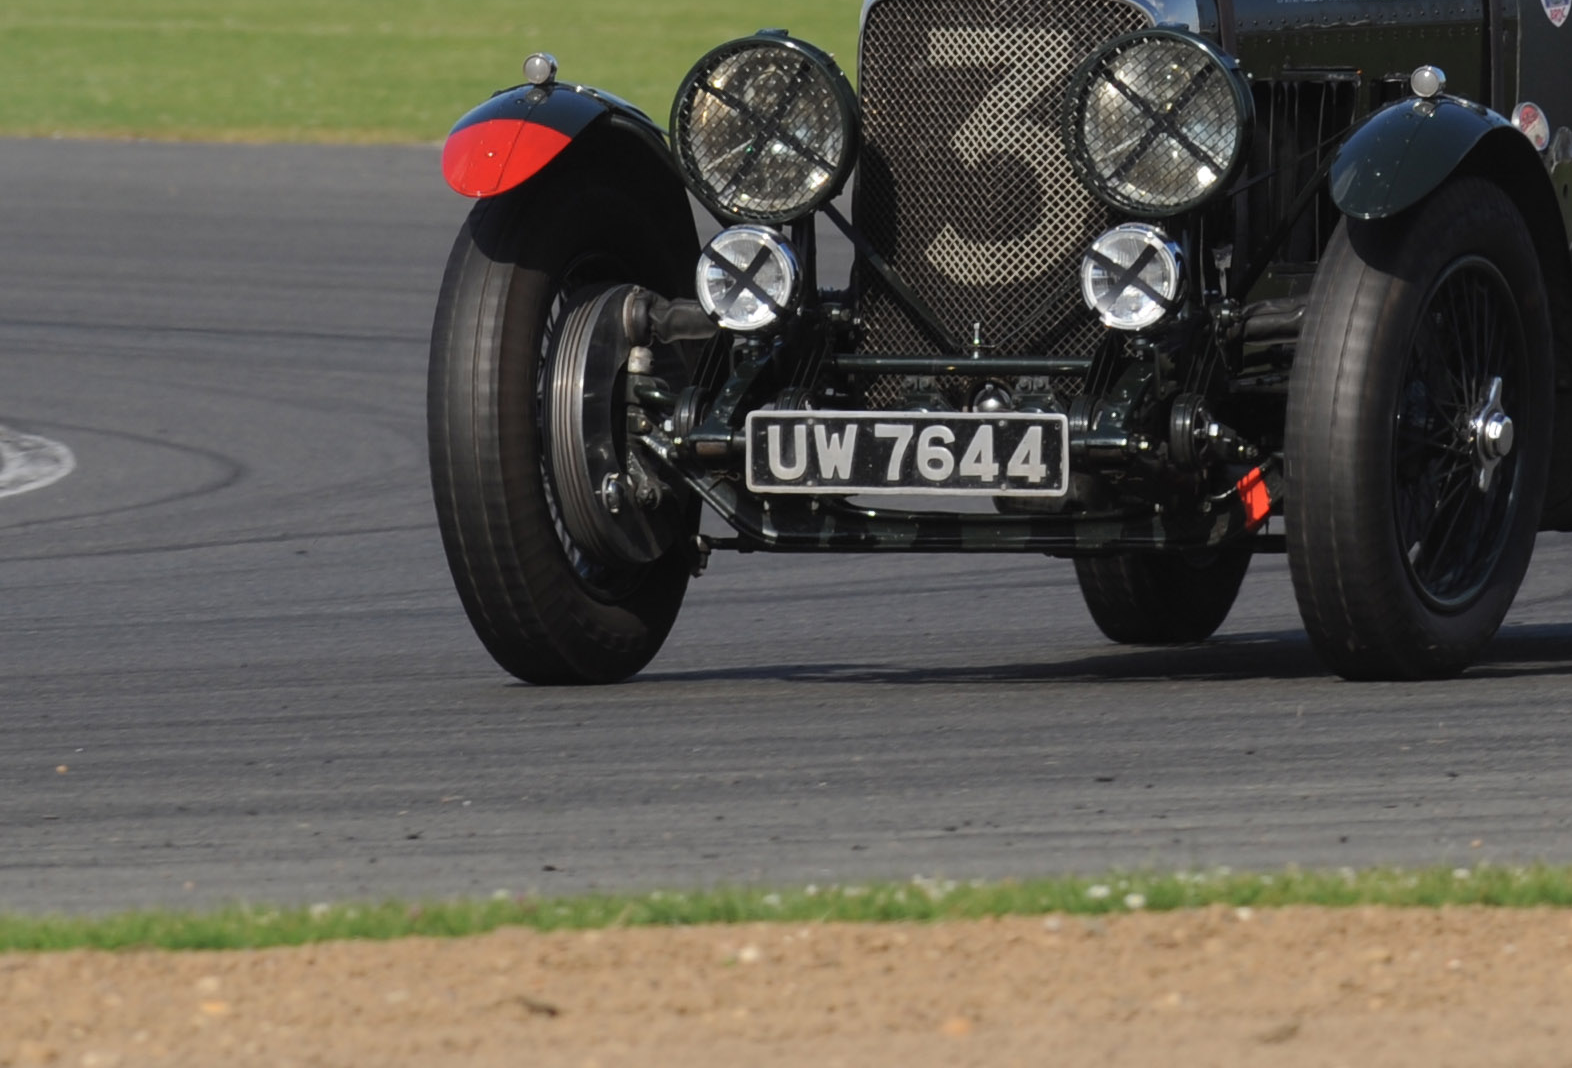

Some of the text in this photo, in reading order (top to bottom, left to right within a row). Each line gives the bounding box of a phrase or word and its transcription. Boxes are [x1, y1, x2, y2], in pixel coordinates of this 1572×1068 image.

[924, 28, 1099, 288] 3
[766, 423, 1048, 483] UW 7644
